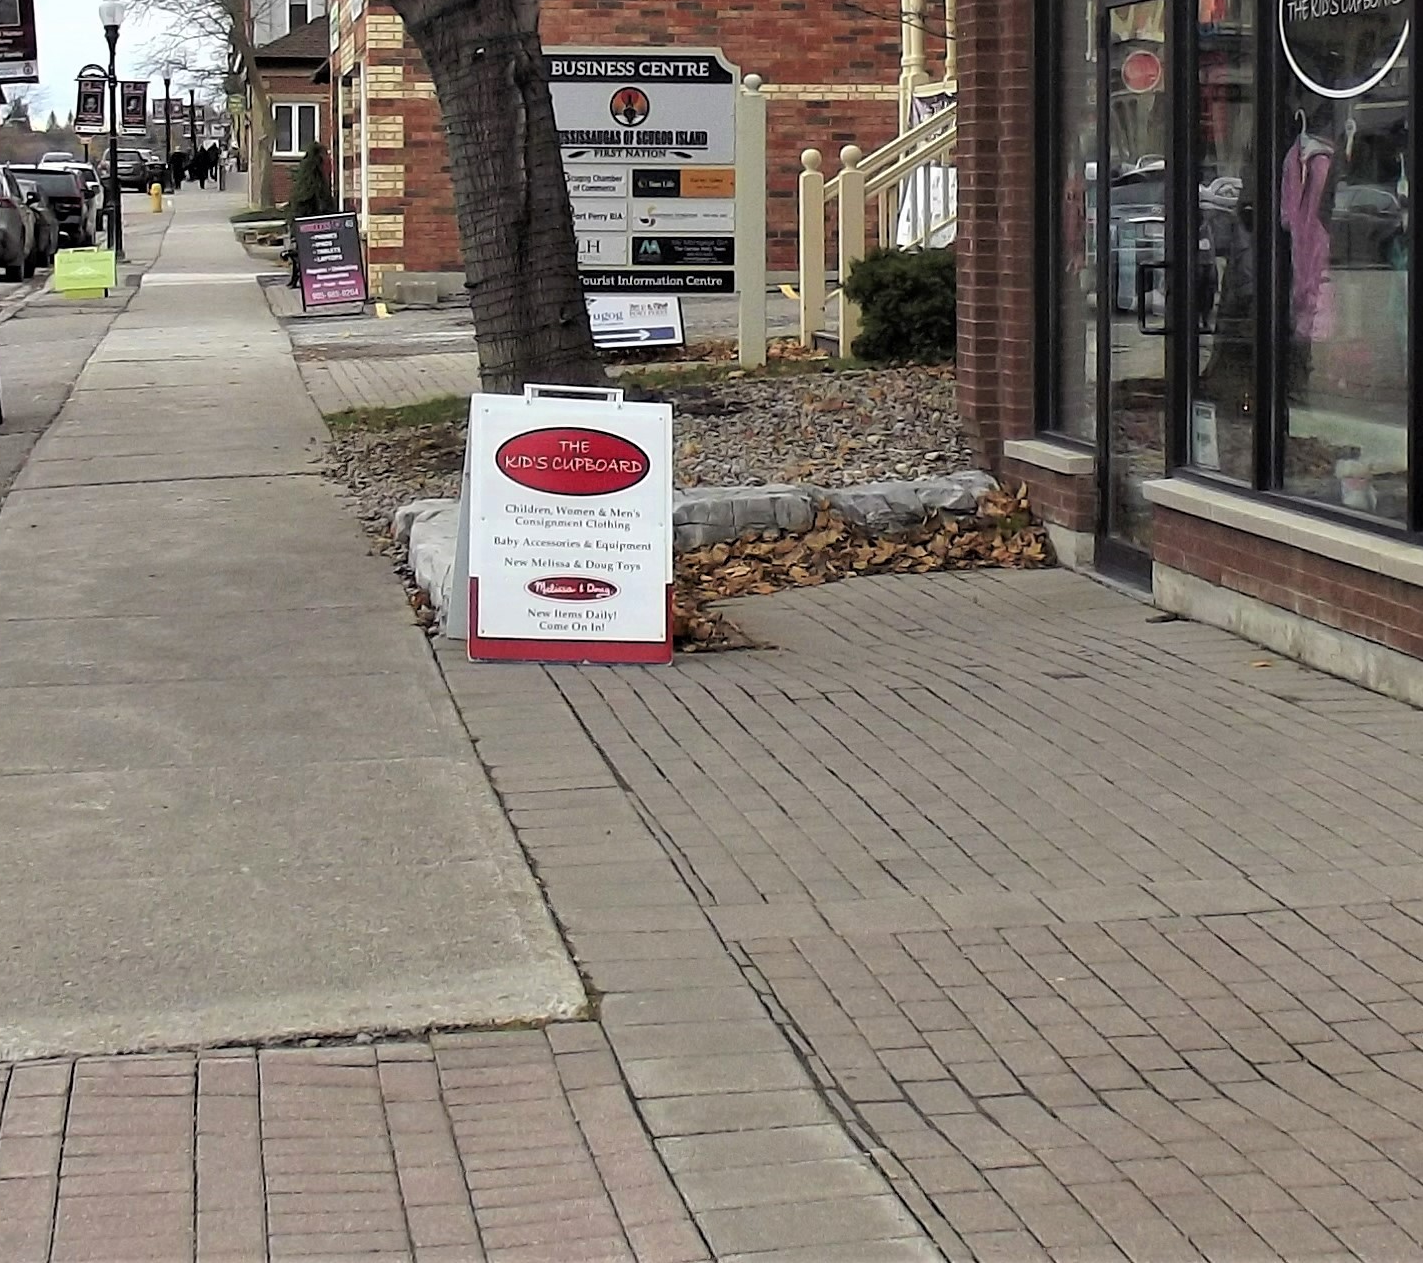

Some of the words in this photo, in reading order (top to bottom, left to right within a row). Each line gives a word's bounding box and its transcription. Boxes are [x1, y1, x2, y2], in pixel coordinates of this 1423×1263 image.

[550, 61, 635, 77] BUSINESS
[638, 61, 710, 77] CENTRE
[560, 130, 622, 146] ISSISSAUGAS
[676, 130, 709, 146] ISLAND
[594, 149, 623, 158] FIRST
[627, 148, 667, 158] NATION
[593, 174, 622, 182] Chamber
[617, 275, 684, 286] Information
[686, 275, 723, 286] Centre
[593, 311, 624, 322] ugog
[559, 440, 590, 453] THE
[505, 455, 548, 469] KID'S
[552, 457, 643, 474] CUPBOARD
[505, 504, 552, 516] Children,
[556, 506, 595, 517] Women
[598, 508, 607, 517] &
[610, 508, 641, 518] Men's
[515, 516, 583, 529] Consignment
[586, 519, 631, 532] Clothing
[494, 536, 518, 548] Baby
[523, 537, 581, 548] Accessories
[584, 540, 592, 549] &
[595, 540, 652, 552] Equipment
[504, 557, 528, 567] New
[531, 558, 570, 569] Melissa
[573, 560, 582, 569] &
[585, 560, 614, 572] Doug
[617, 561, 641, 573] Toys
[533, 581, 576, 595] Melissa
[586, 583, 610, 599] Doug
[527, 608, 550, 618] New
[554, 609, 583, 619] Items
[585, 610, 617, 622] Daily!
[539, 621, 568, 631] Come
[571, 622, 588, 632] On
[591, 622, 605, 632] In!
